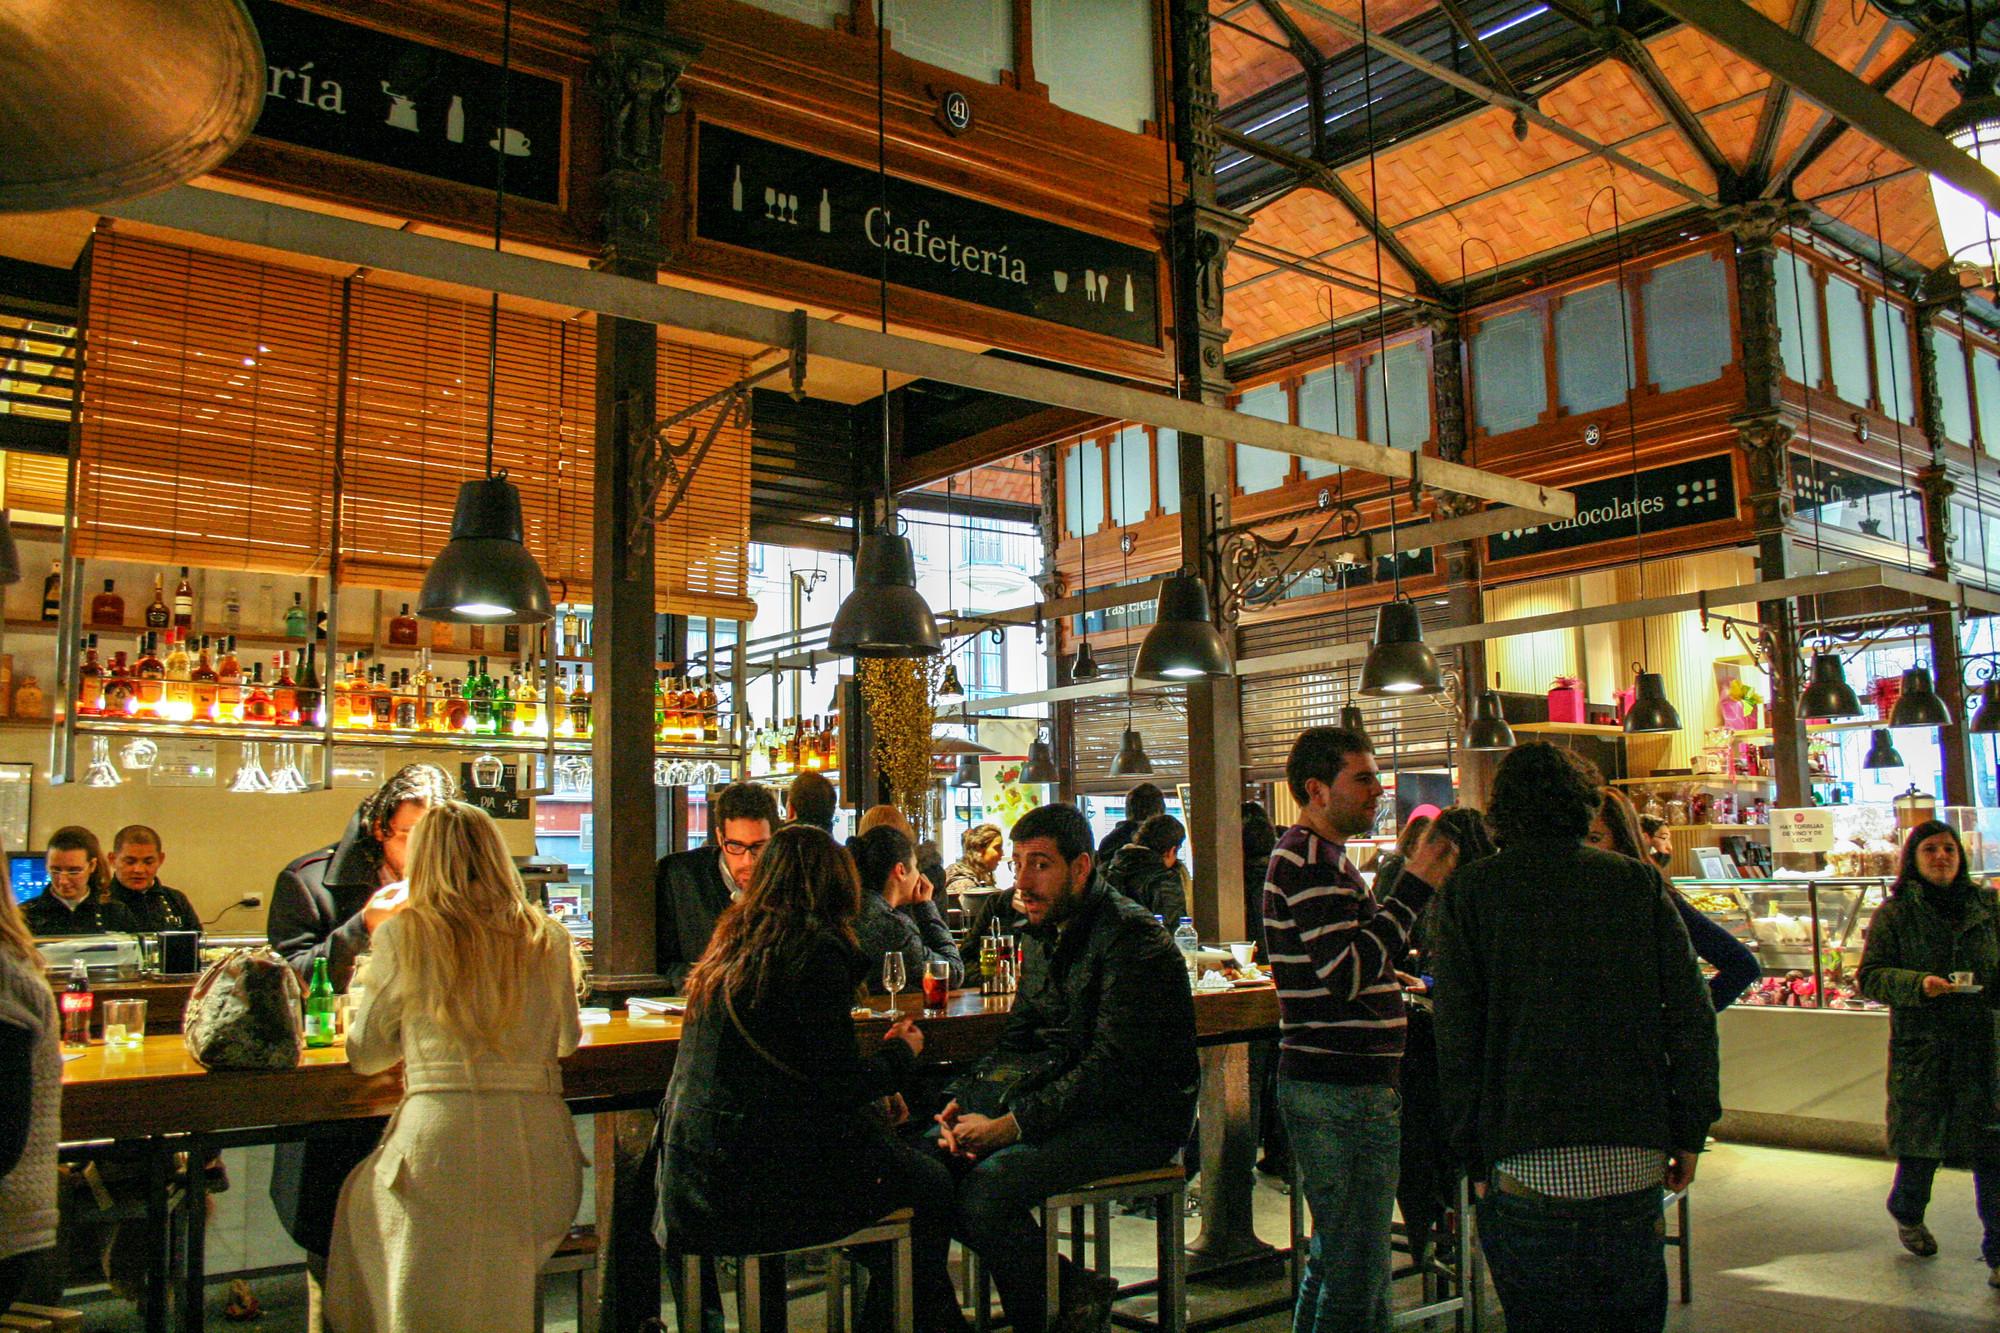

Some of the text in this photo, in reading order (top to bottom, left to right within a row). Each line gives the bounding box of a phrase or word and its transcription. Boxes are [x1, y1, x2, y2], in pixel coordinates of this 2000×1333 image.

[950, 100, 966, 120] 41
[864, 206, 1029, 285] Cafetería
[1586, 429, 1598, 442] 26
